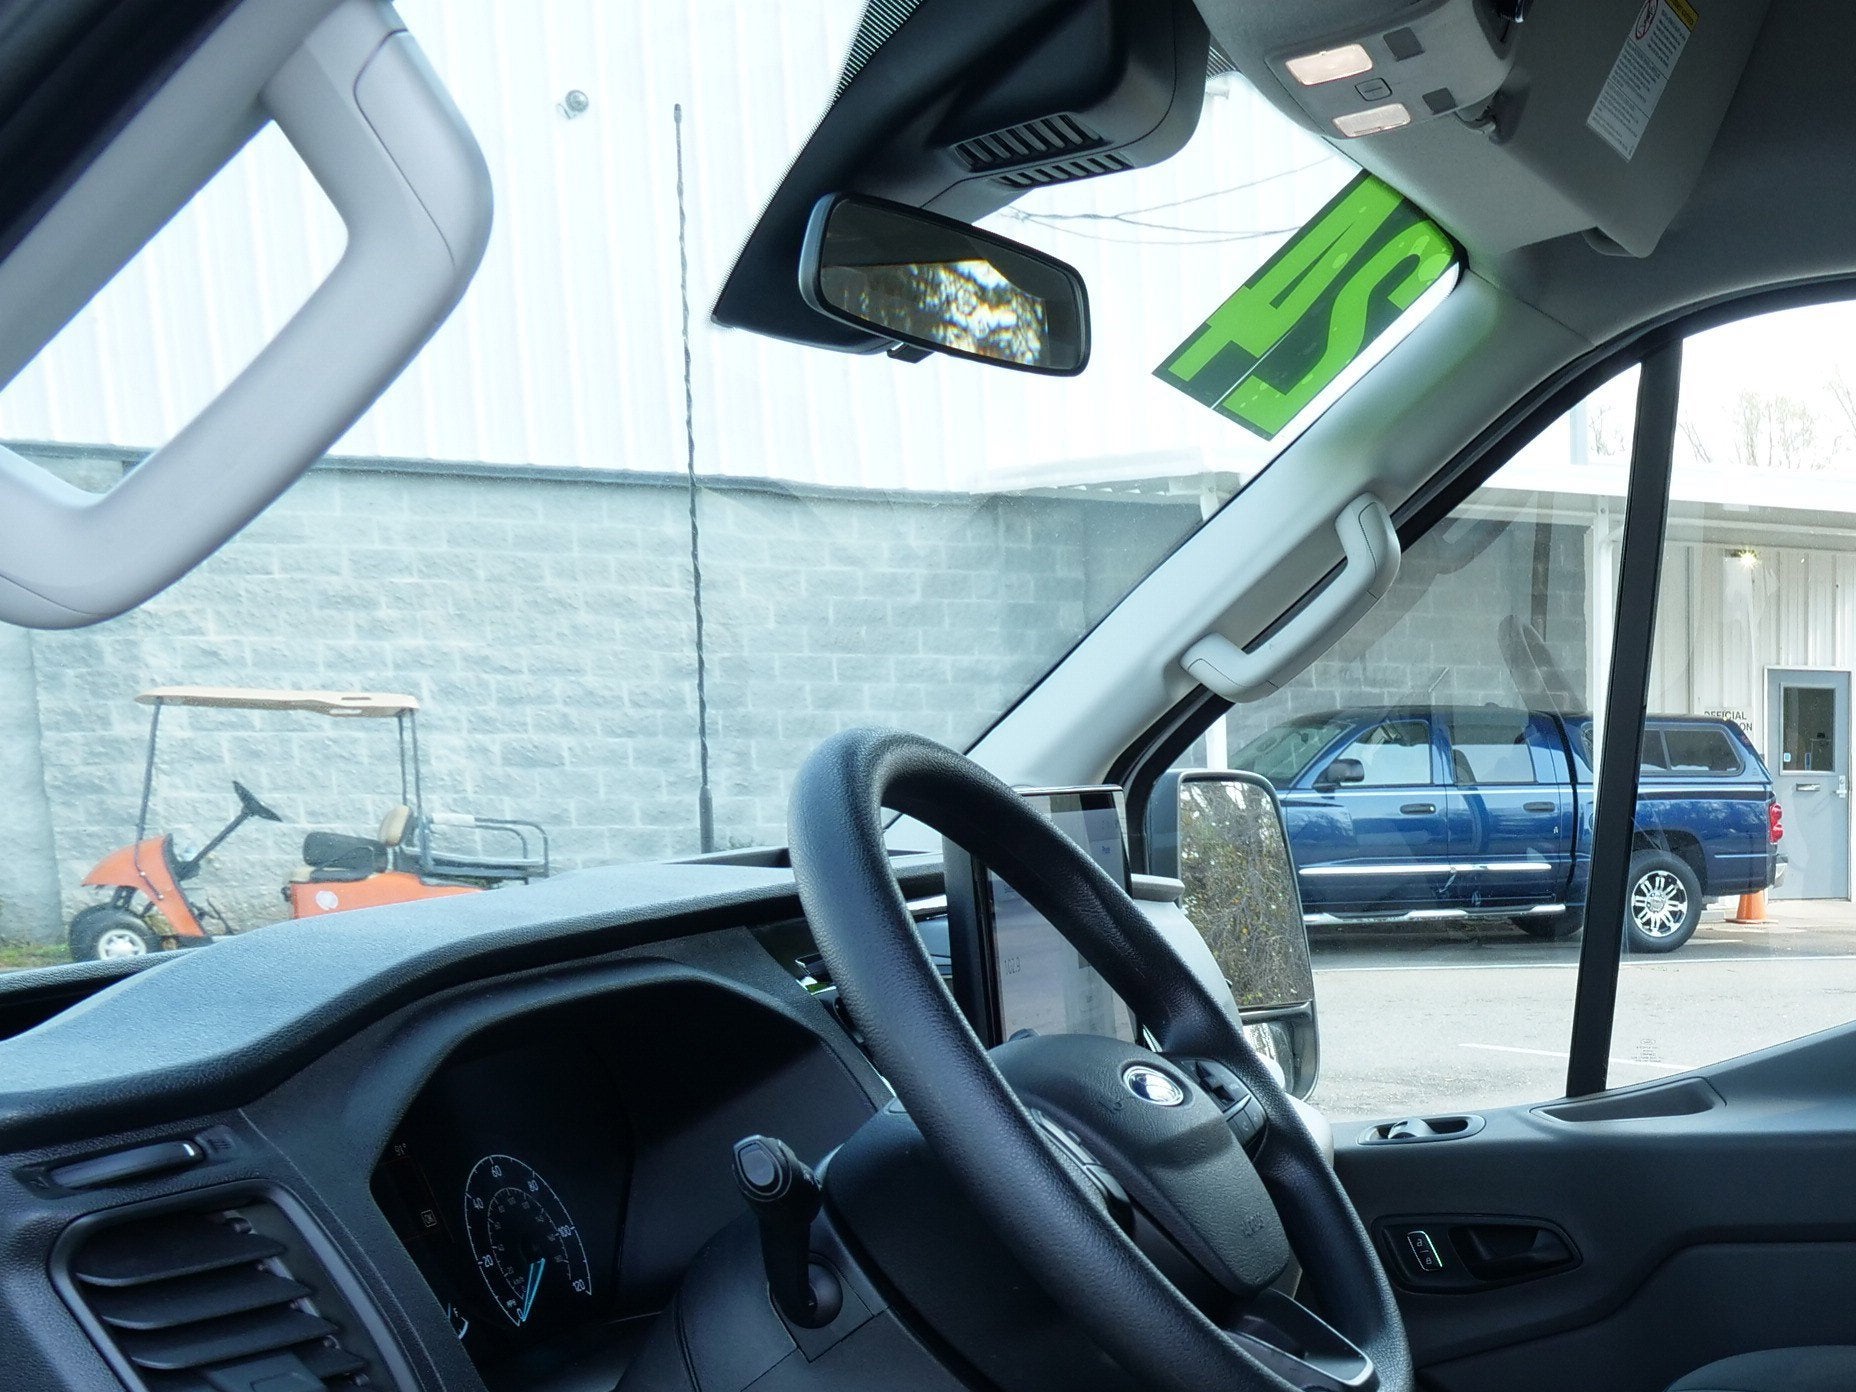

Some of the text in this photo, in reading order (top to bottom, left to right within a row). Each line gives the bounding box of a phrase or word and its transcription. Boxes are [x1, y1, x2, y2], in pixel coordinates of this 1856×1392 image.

[1704, 711, 1747, 720] OFFICIAL
[491, 1165, 502, 1178] 60
[527, 1180, 539, 1192] 80
[473, 1197, 484, 1210] 40
[482, 1255, 494, 1268] 20
